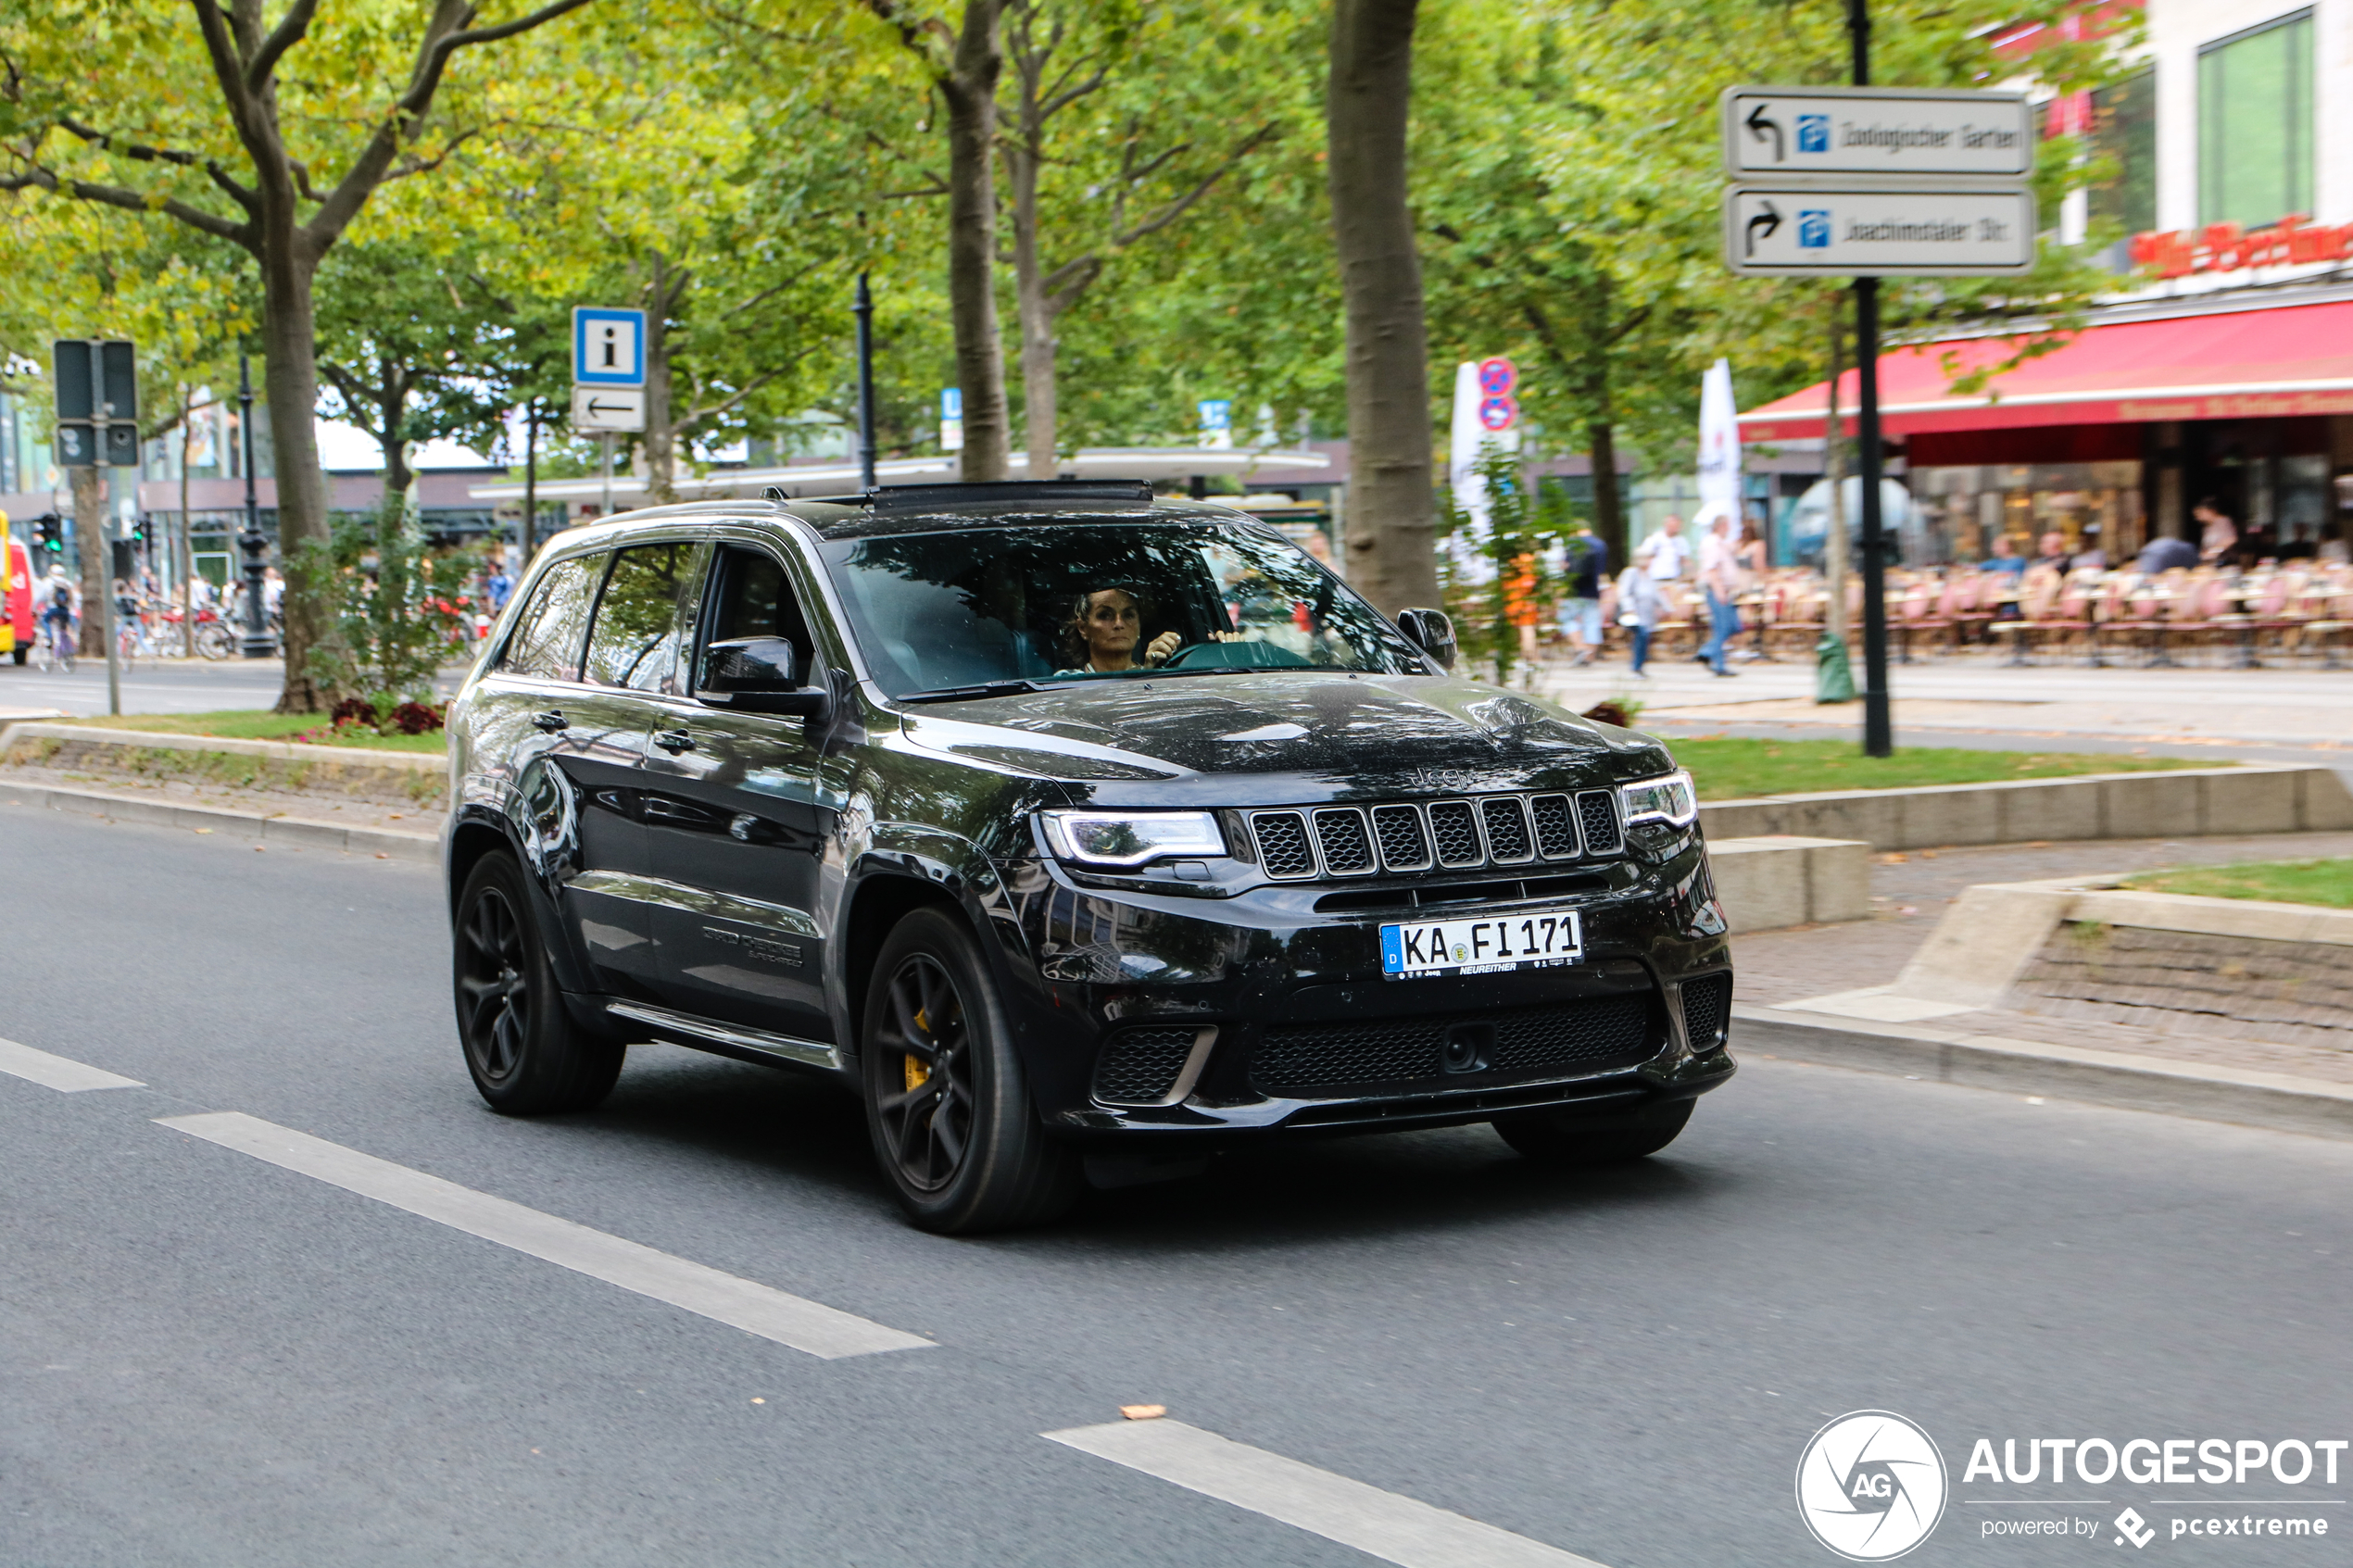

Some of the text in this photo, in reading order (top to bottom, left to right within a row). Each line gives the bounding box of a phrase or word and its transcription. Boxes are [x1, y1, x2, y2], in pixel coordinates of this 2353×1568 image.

[1410, 767, 1471, 790] Jeep
[740, 935, 801, 958] CHEROKEE
[1403, 916, 1579, 965] KA FI 171
[1389, 953, 1397, 965] D
[1459, 962, 1517, 975] NEUREITHER
